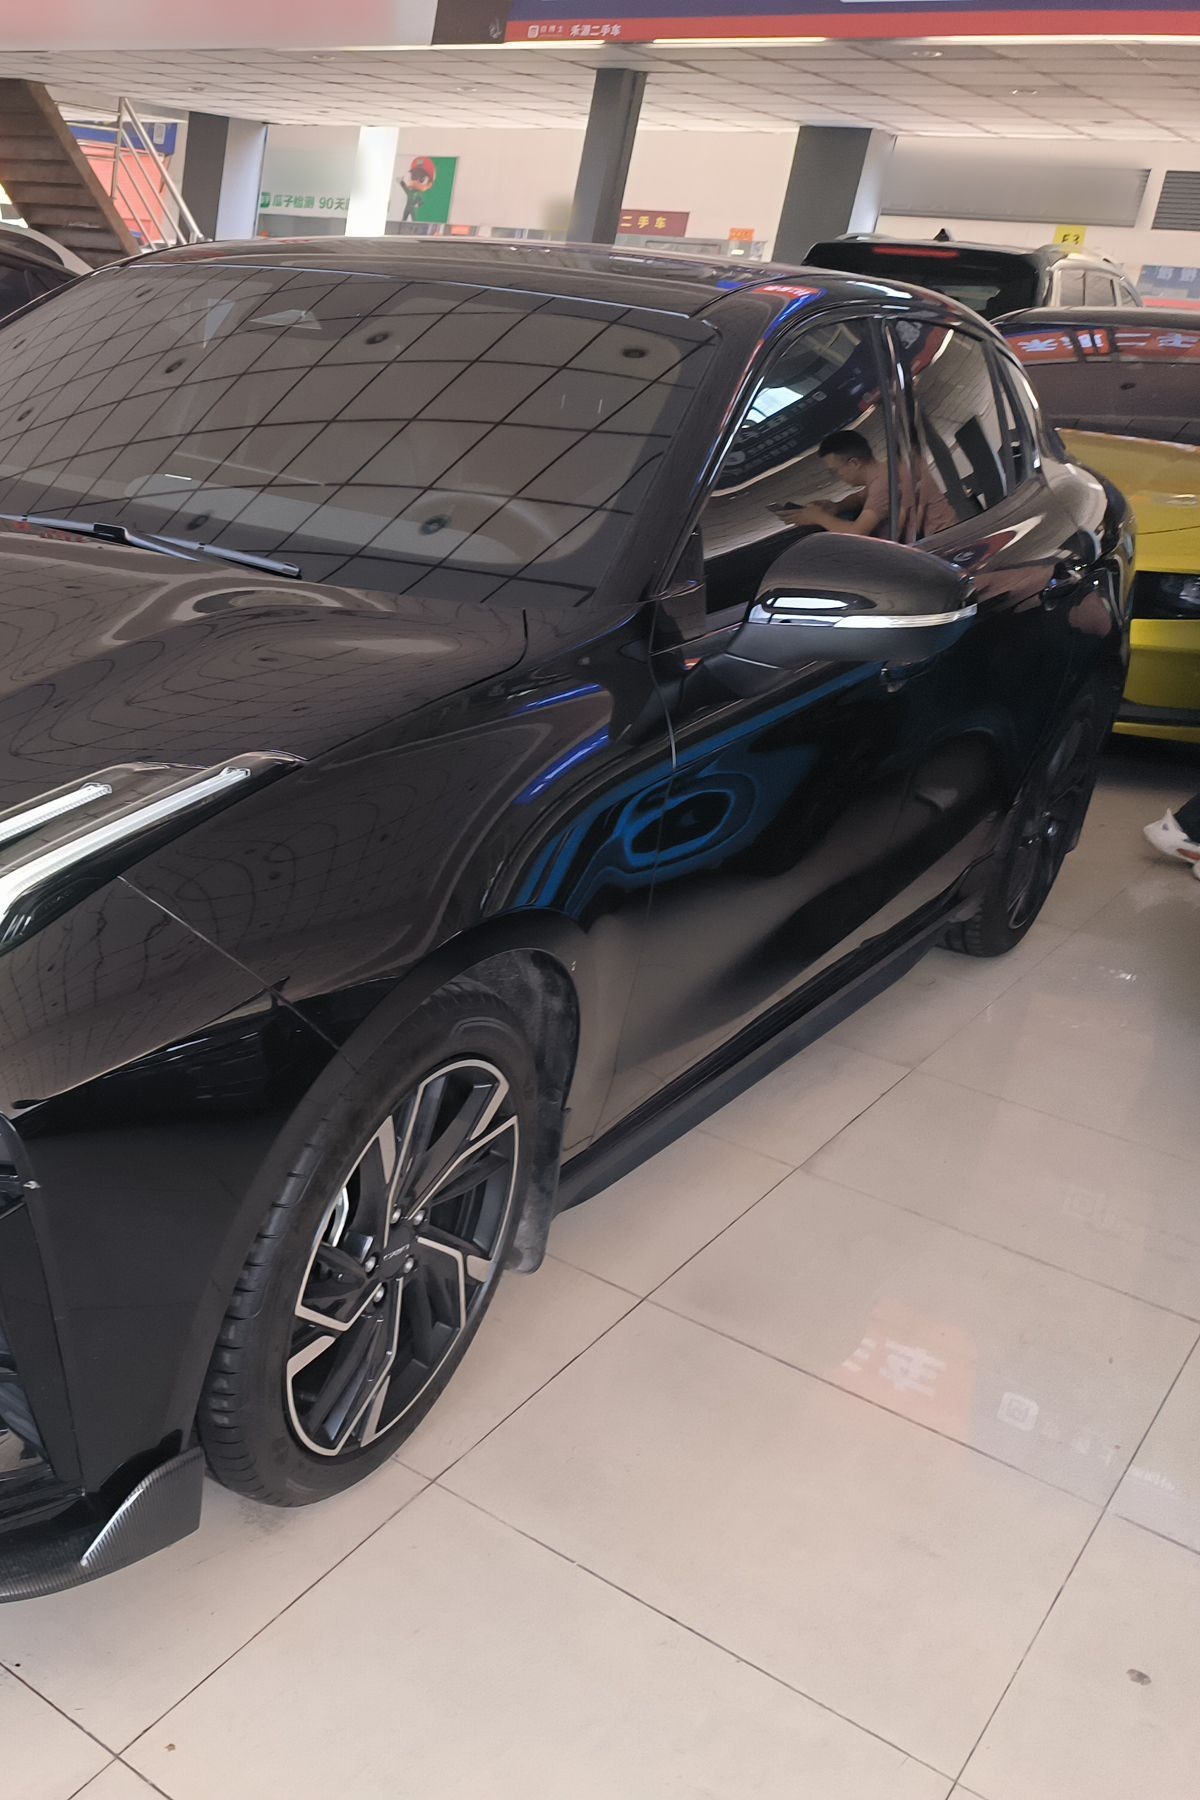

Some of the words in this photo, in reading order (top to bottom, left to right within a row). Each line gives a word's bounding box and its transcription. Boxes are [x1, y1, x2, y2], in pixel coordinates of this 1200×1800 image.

[319, 196, 350, 210] 90天
[620, 215, 667, 229] 二手车
